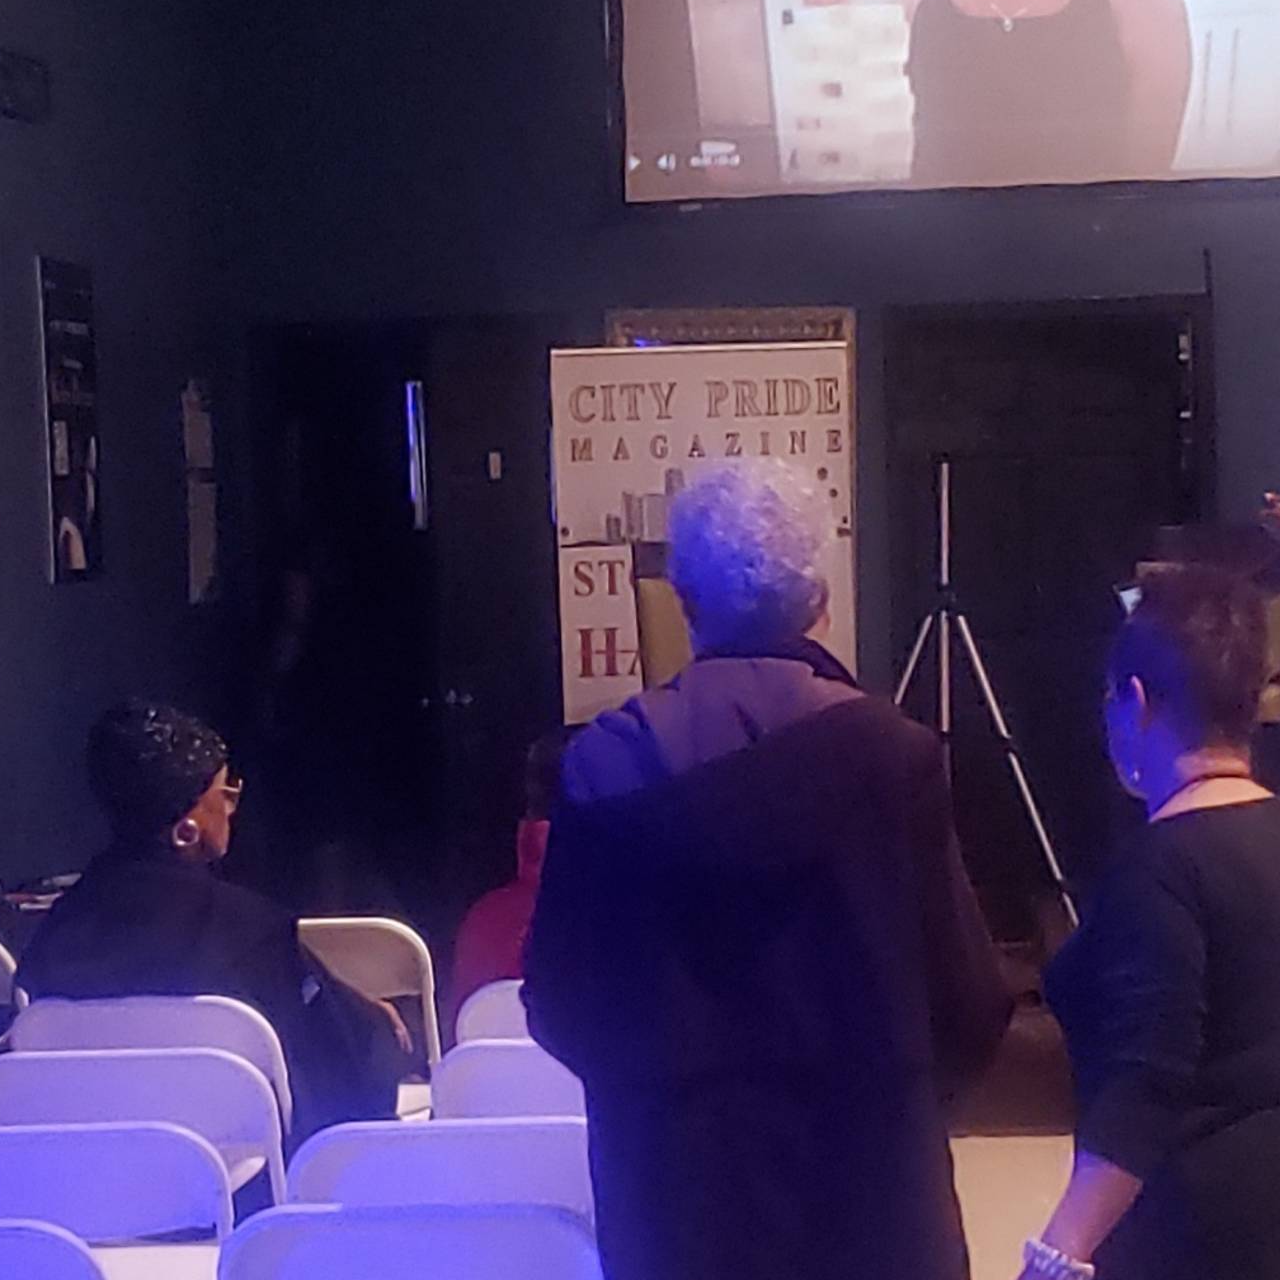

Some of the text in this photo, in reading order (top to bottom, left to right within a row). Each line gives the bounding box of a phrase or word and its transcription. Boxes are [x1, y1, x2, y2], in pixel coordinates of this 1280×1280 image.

[568, 376, 842, 423] CITY PRIDE
[570, 428, 843, 463] MAGAZINE
[573, 560, 636, 597] ST
